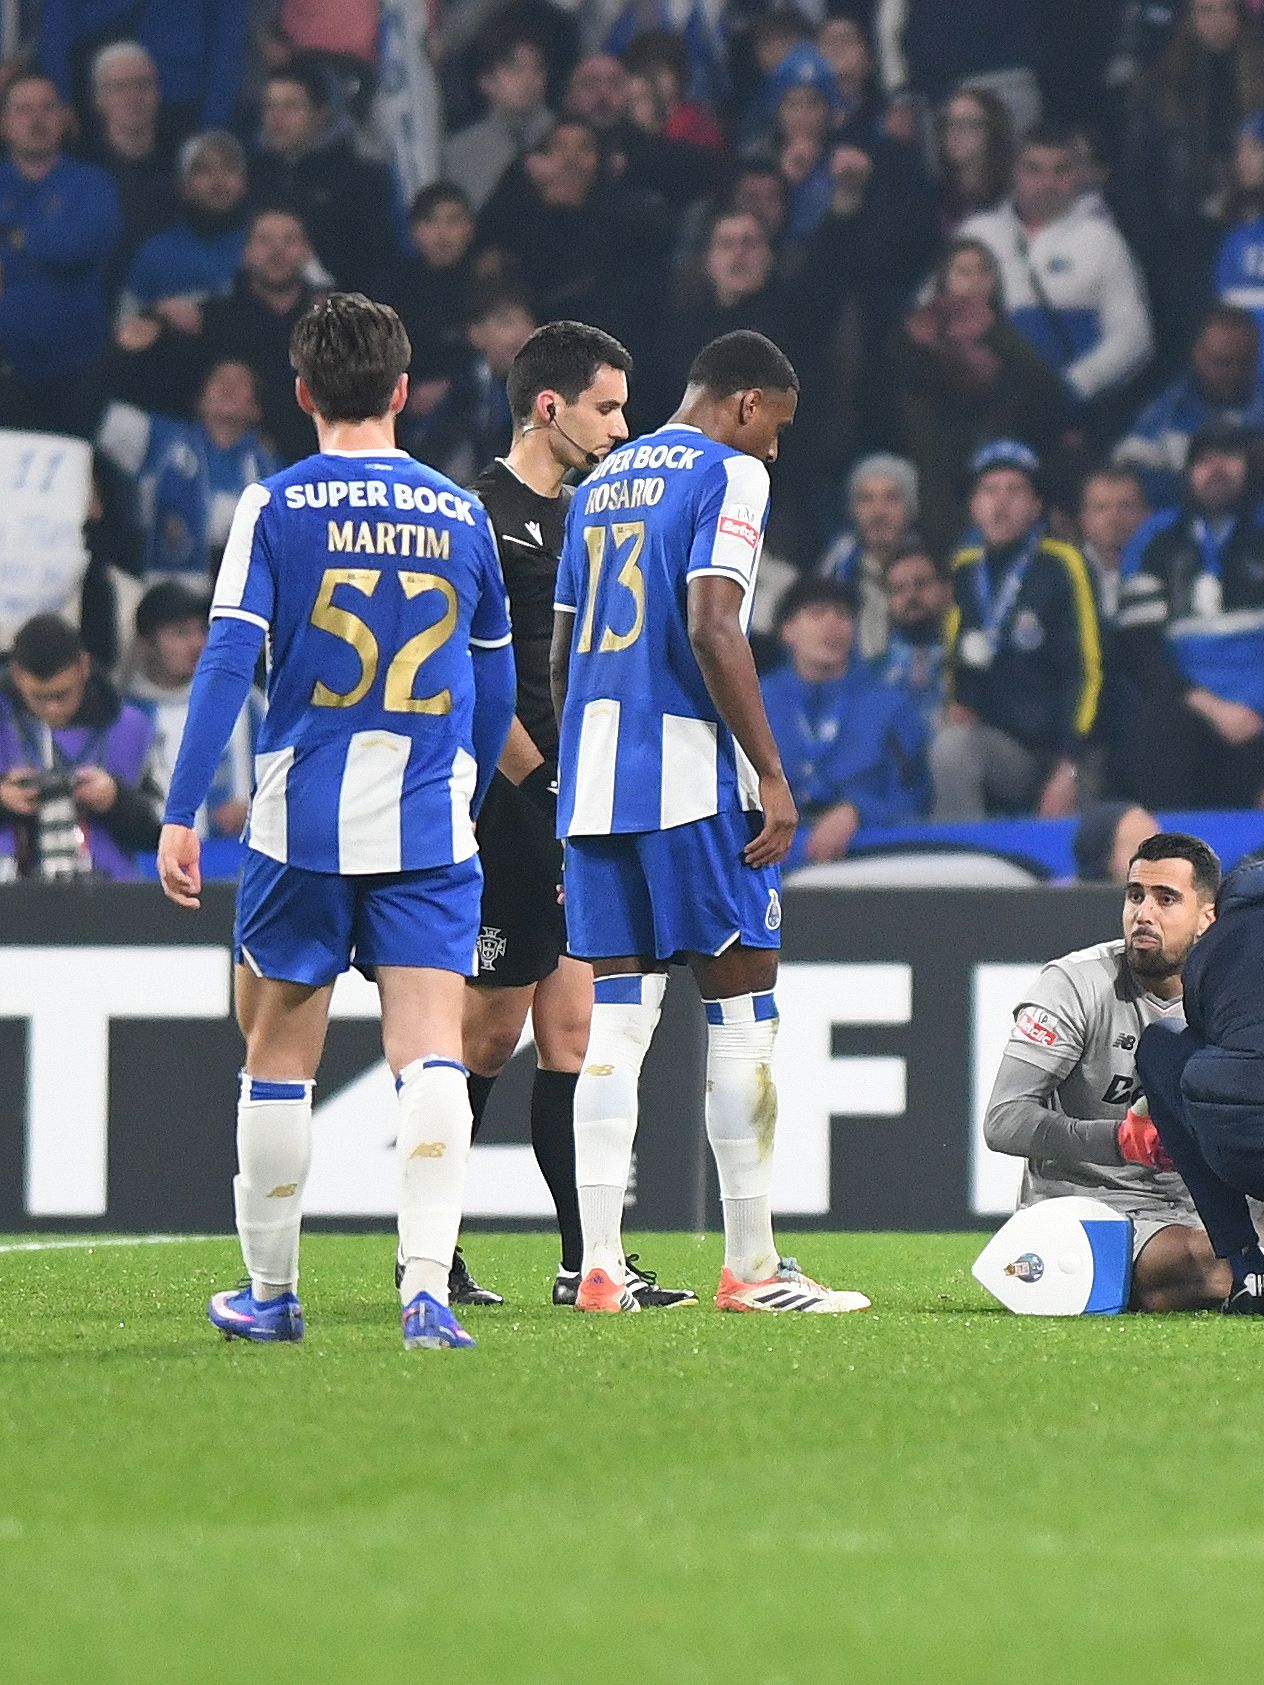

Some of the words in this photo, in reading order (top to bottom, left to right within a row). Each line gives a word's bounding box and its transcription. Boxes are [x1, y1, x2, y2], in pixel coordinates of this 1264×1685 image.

[633, 445, 704, 470] BOCK
[285, 480, 389, 509] SUPER
[393, 482, 475, 526] BOCK
[584, 477, 665, 515] ROSARIO
[327, 520, 449, 560] MARTIM
[576, 521, 645, 654] 13
[310, 568, 458, 715] 52
